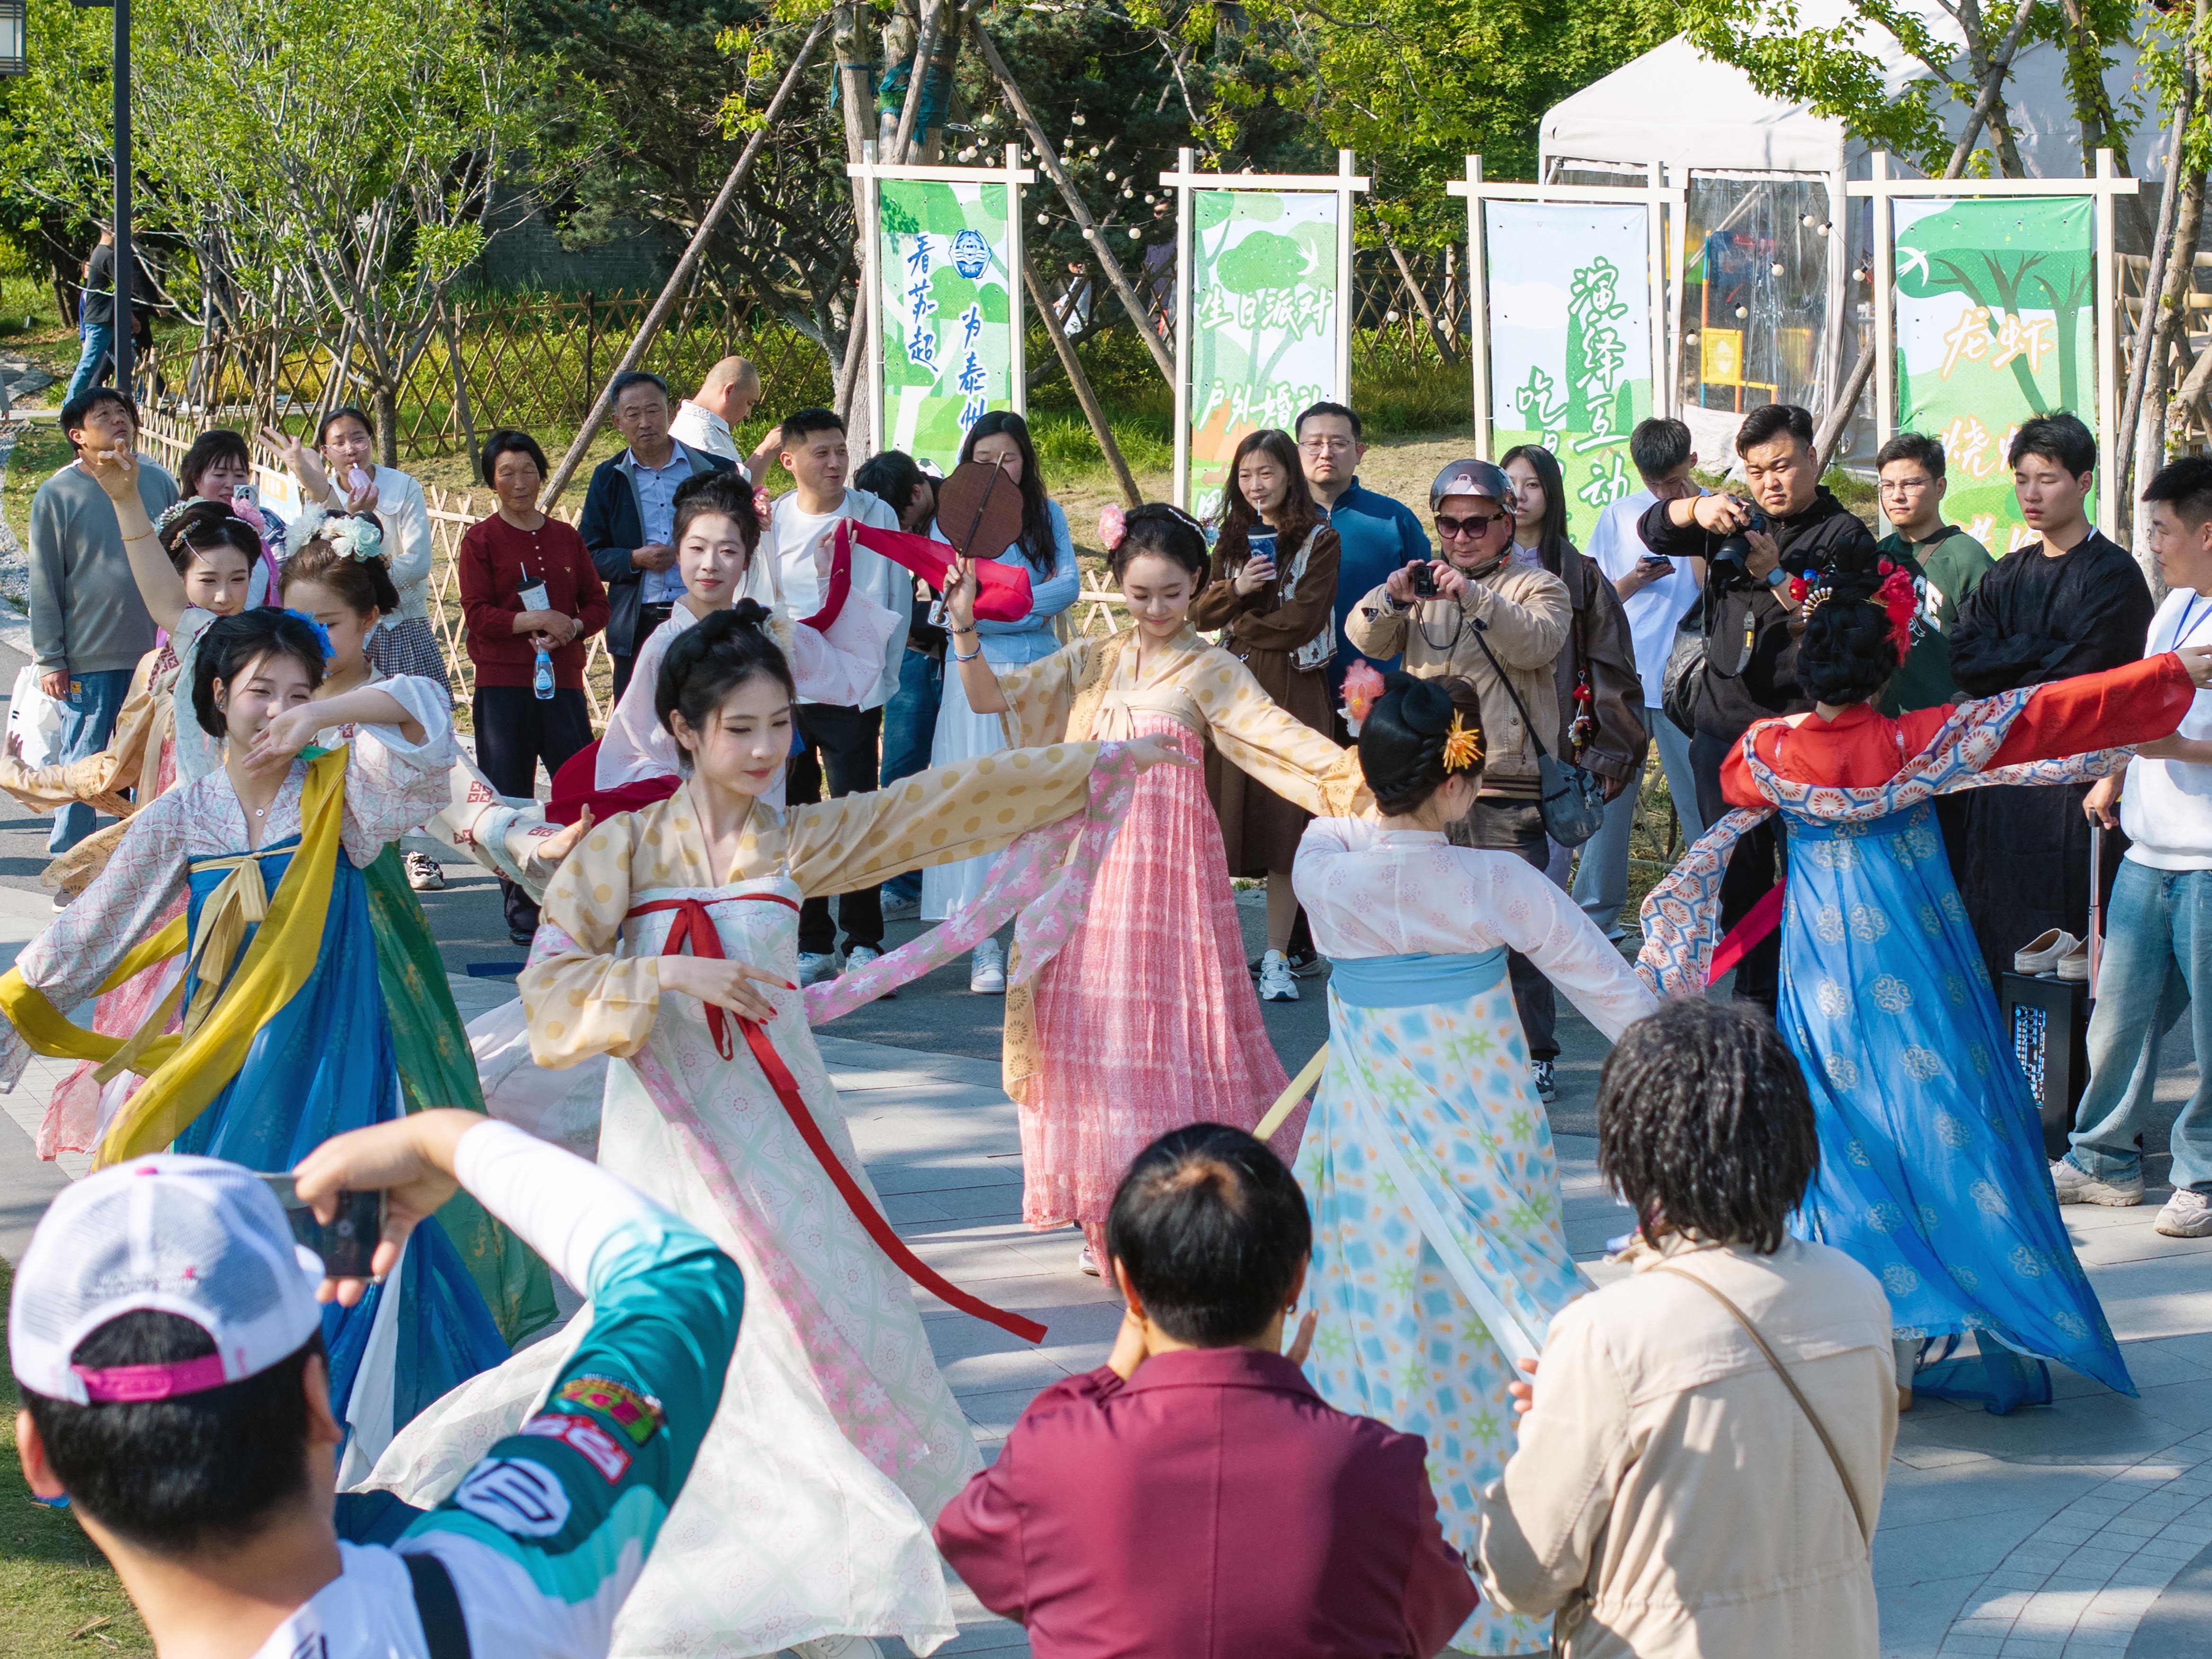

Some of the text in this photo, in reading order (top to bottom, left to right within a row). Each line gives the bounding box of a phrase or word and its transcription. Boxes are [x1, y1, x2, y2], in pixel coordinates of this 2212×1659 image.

[906, 234, 939, 372] 看苏超
[1200, 285, 1330, 339] 生日派对
[1942, 311, 2052, 378] 龙虾
[958, 305, 987, 463] 为泰州
[1568, 259, 1630, 506] 演绎互动
